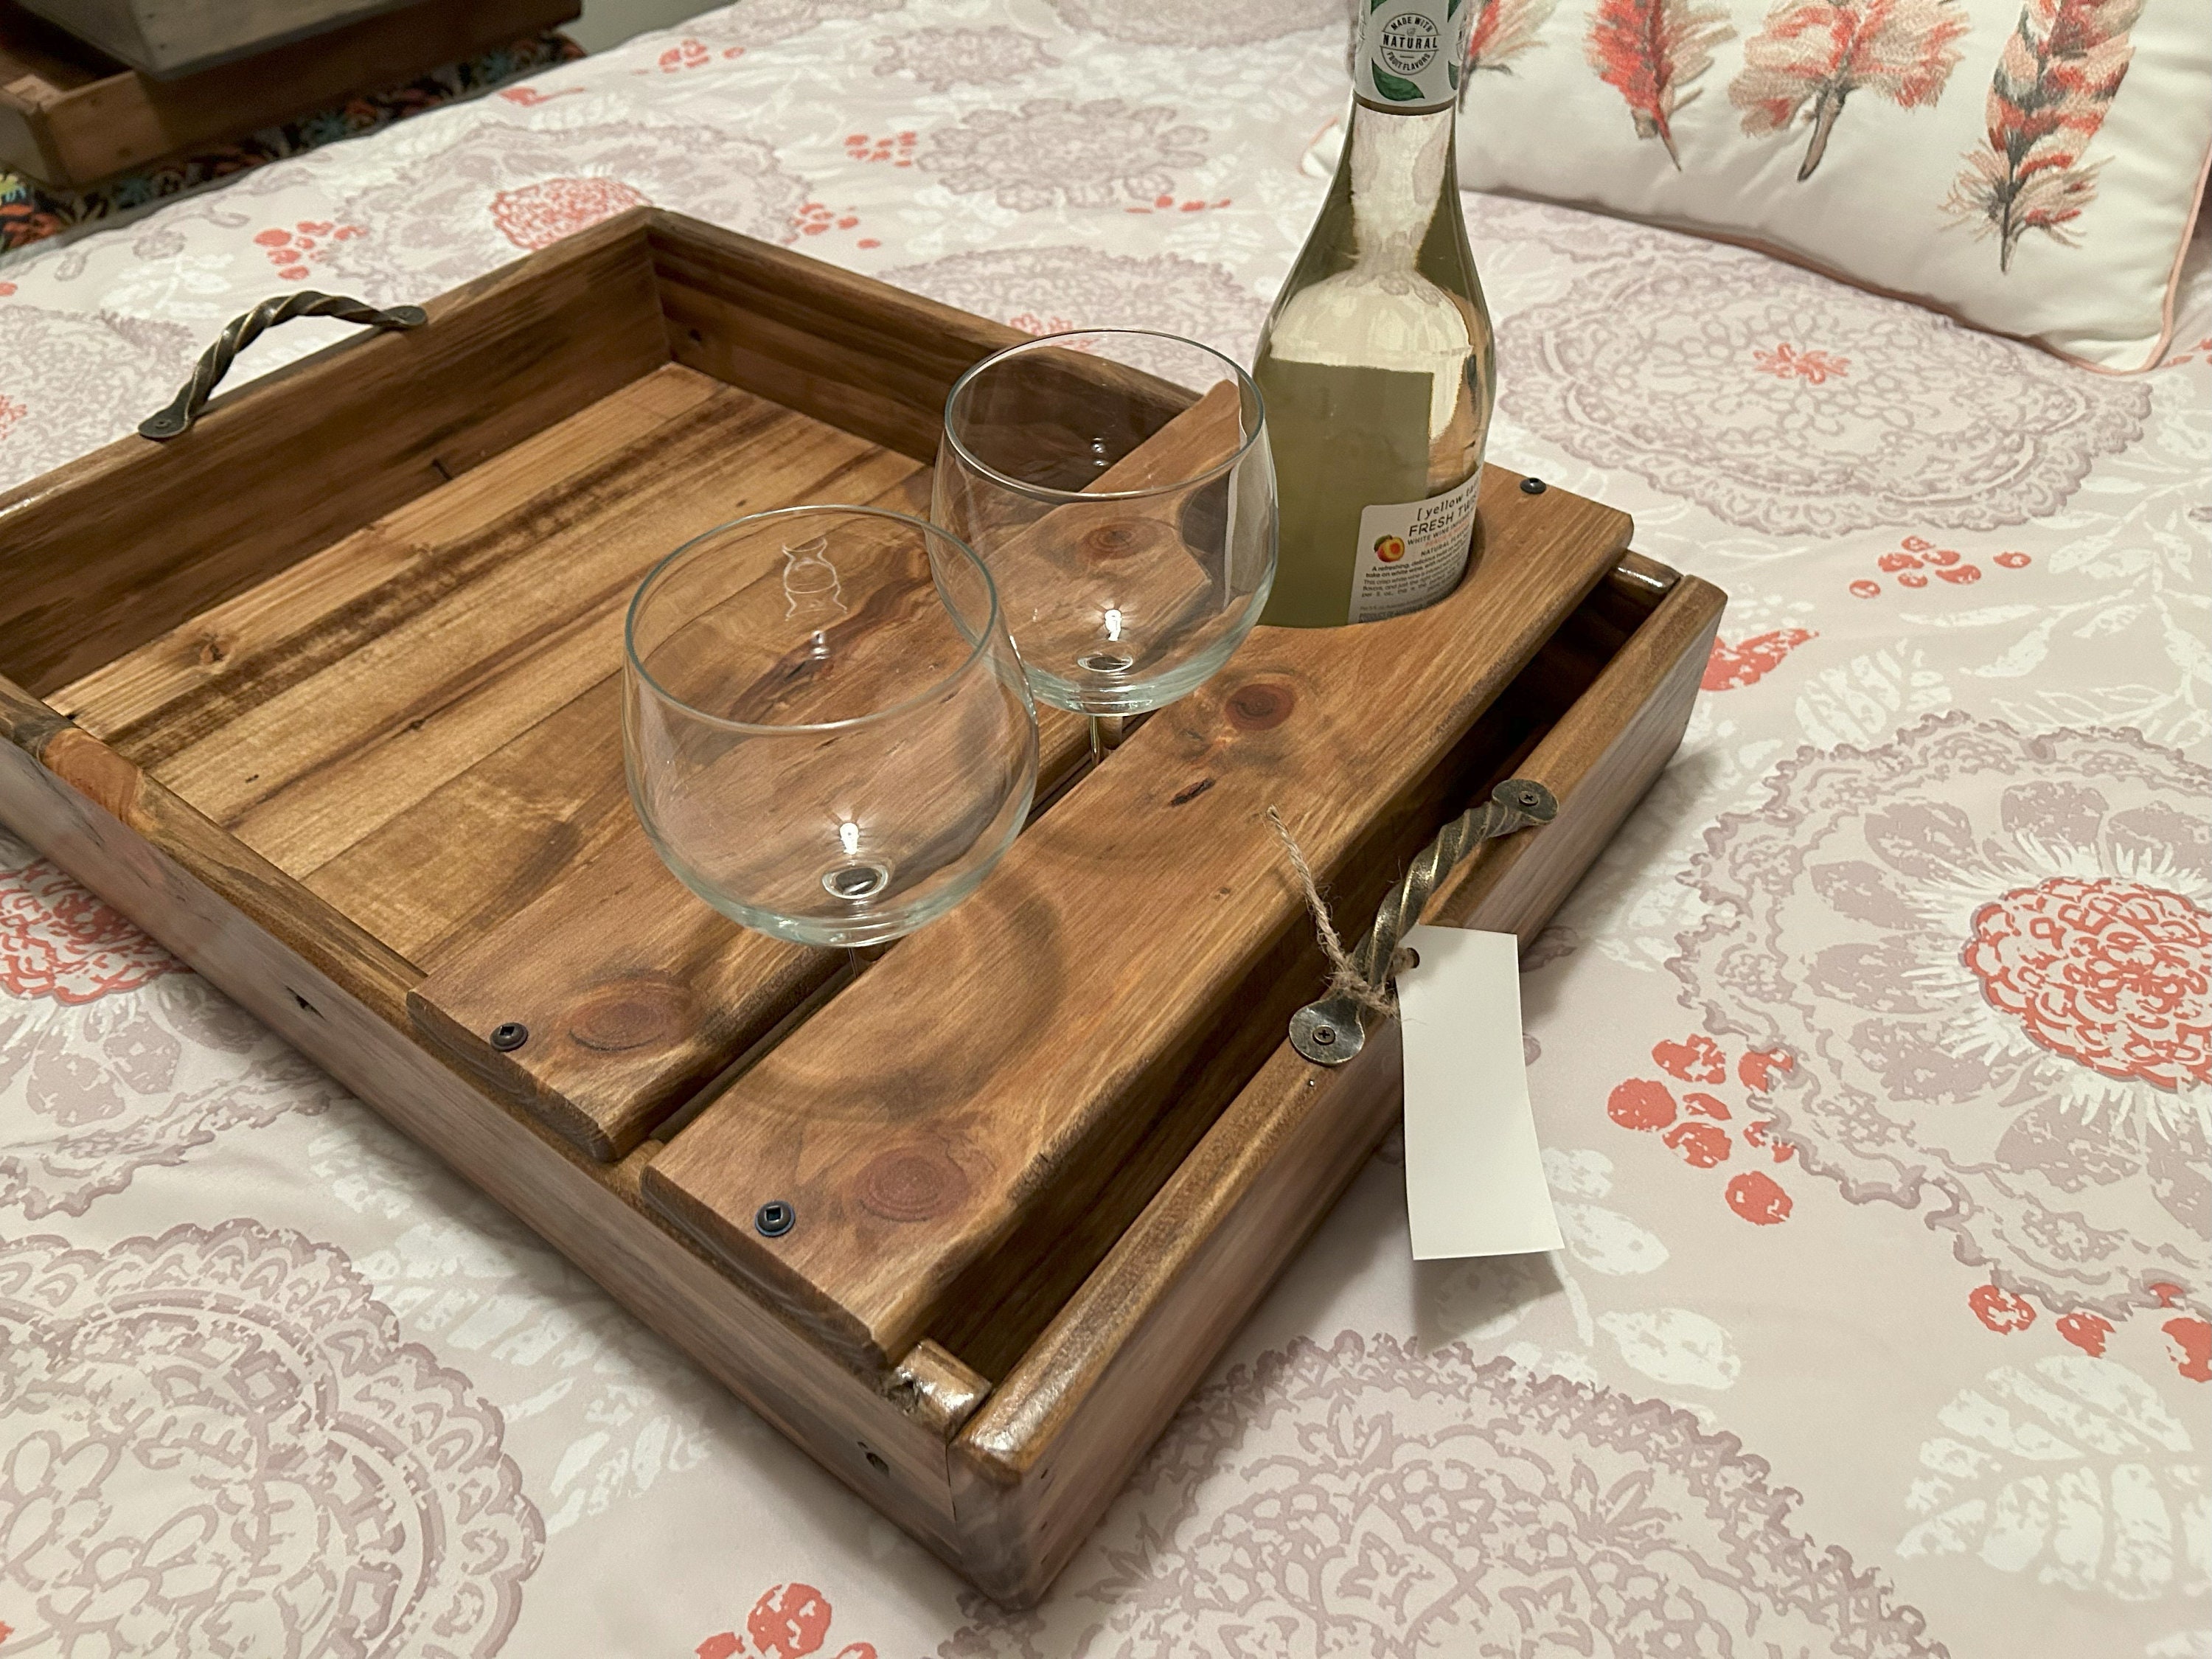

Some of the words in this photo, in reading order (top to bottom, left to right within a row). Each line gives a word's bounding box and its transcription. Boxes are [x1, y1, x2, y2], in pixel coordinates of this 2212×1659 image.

[1391, 16, 1412, 31] MADE
[1414, 17, 1433, 32] WITH
[1383, 34, 1438, 49] NATURAL
[1386, 52, 1402, 68] FRUIT
[1402, 53, 1431, 71] FLAVORS
[1409, 512, 1454, 537] FRESH
[1408, 535, 1431, 545] WHITE
[1433, 527, 1450, 538] WINE
[1421, 541, 1449, 557] NATURAL
